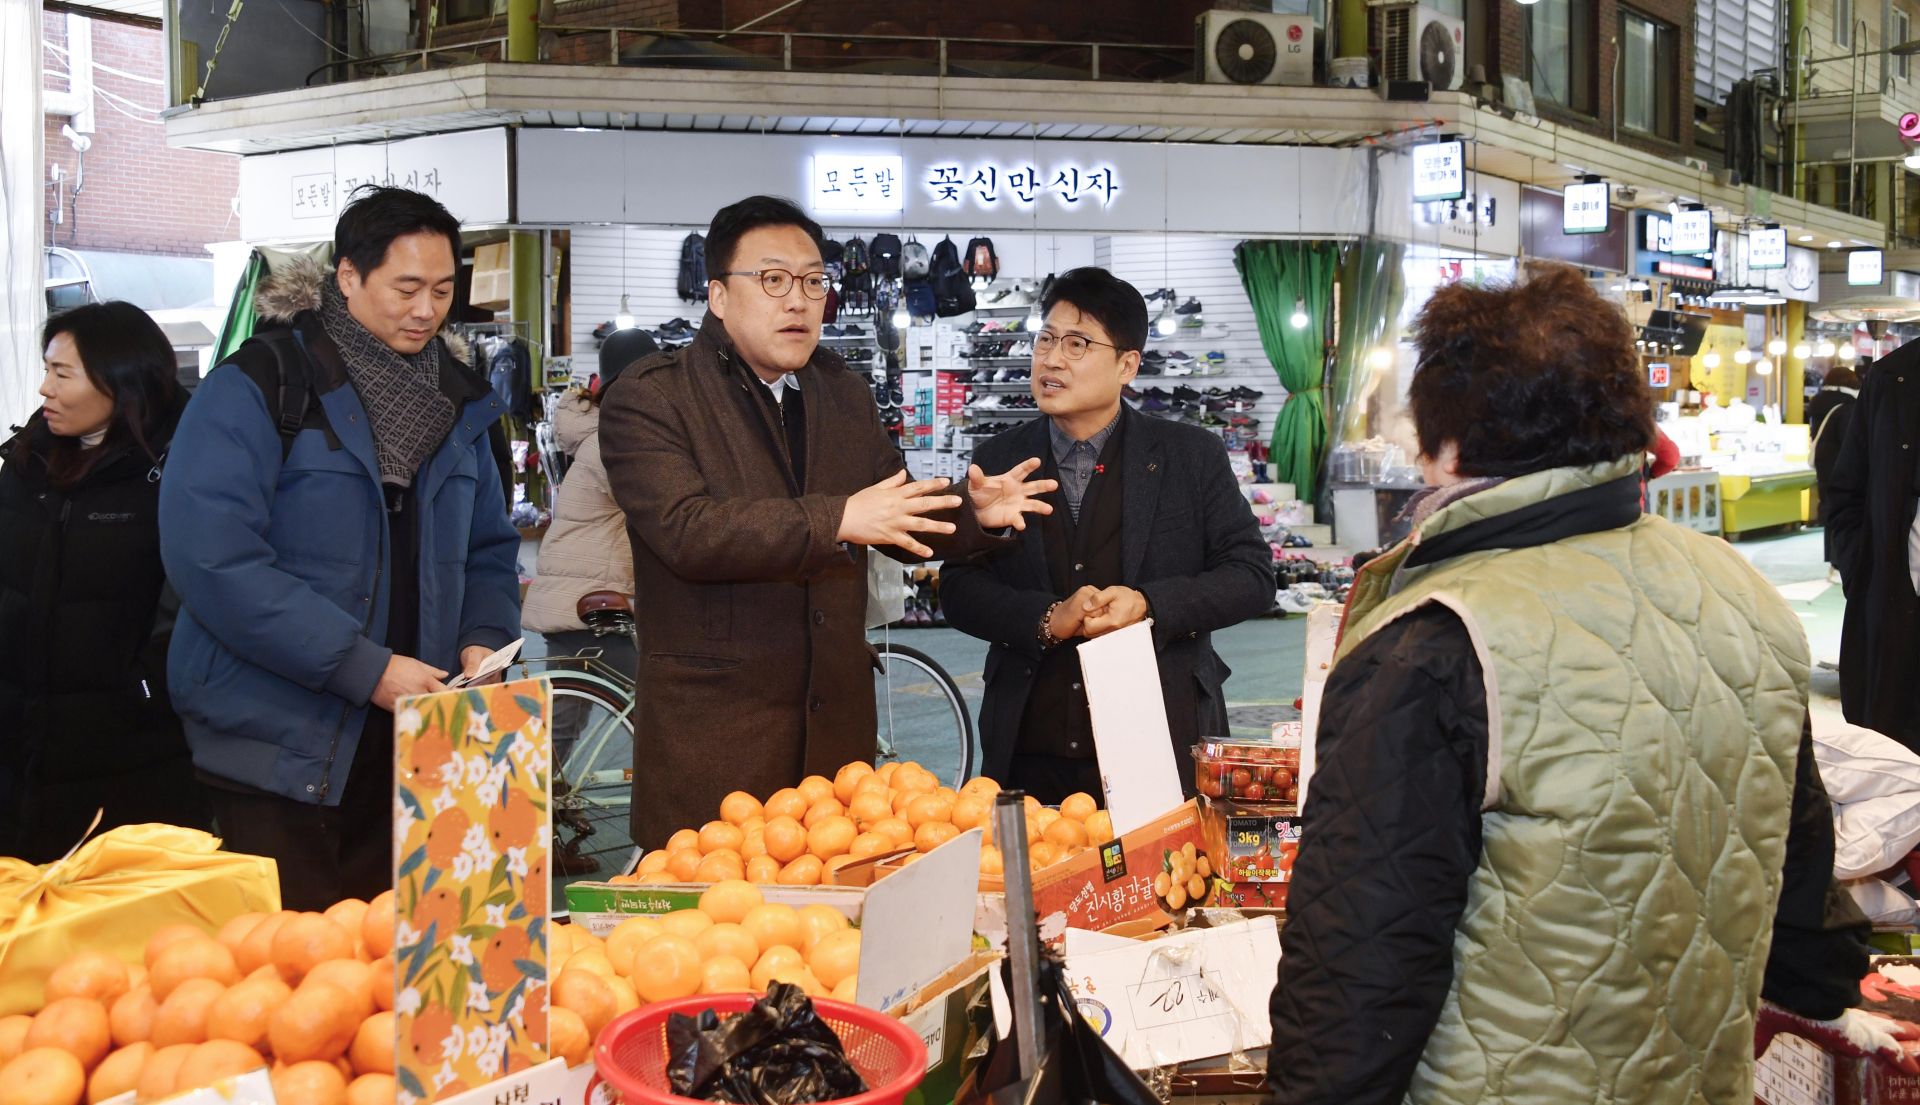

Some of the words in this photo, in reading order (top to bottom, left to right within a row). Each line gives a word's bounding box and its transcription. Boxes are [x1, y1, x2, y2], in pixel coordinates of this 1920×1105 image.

[1287, 43, 1302, 54] LG
[296, 181, 331, 209] 모든발
[821, 166, 896, 199] 모든발
[1238, 831, 1261, 847] 3kg
[1068, 879, 1095, 914] 당도선별
